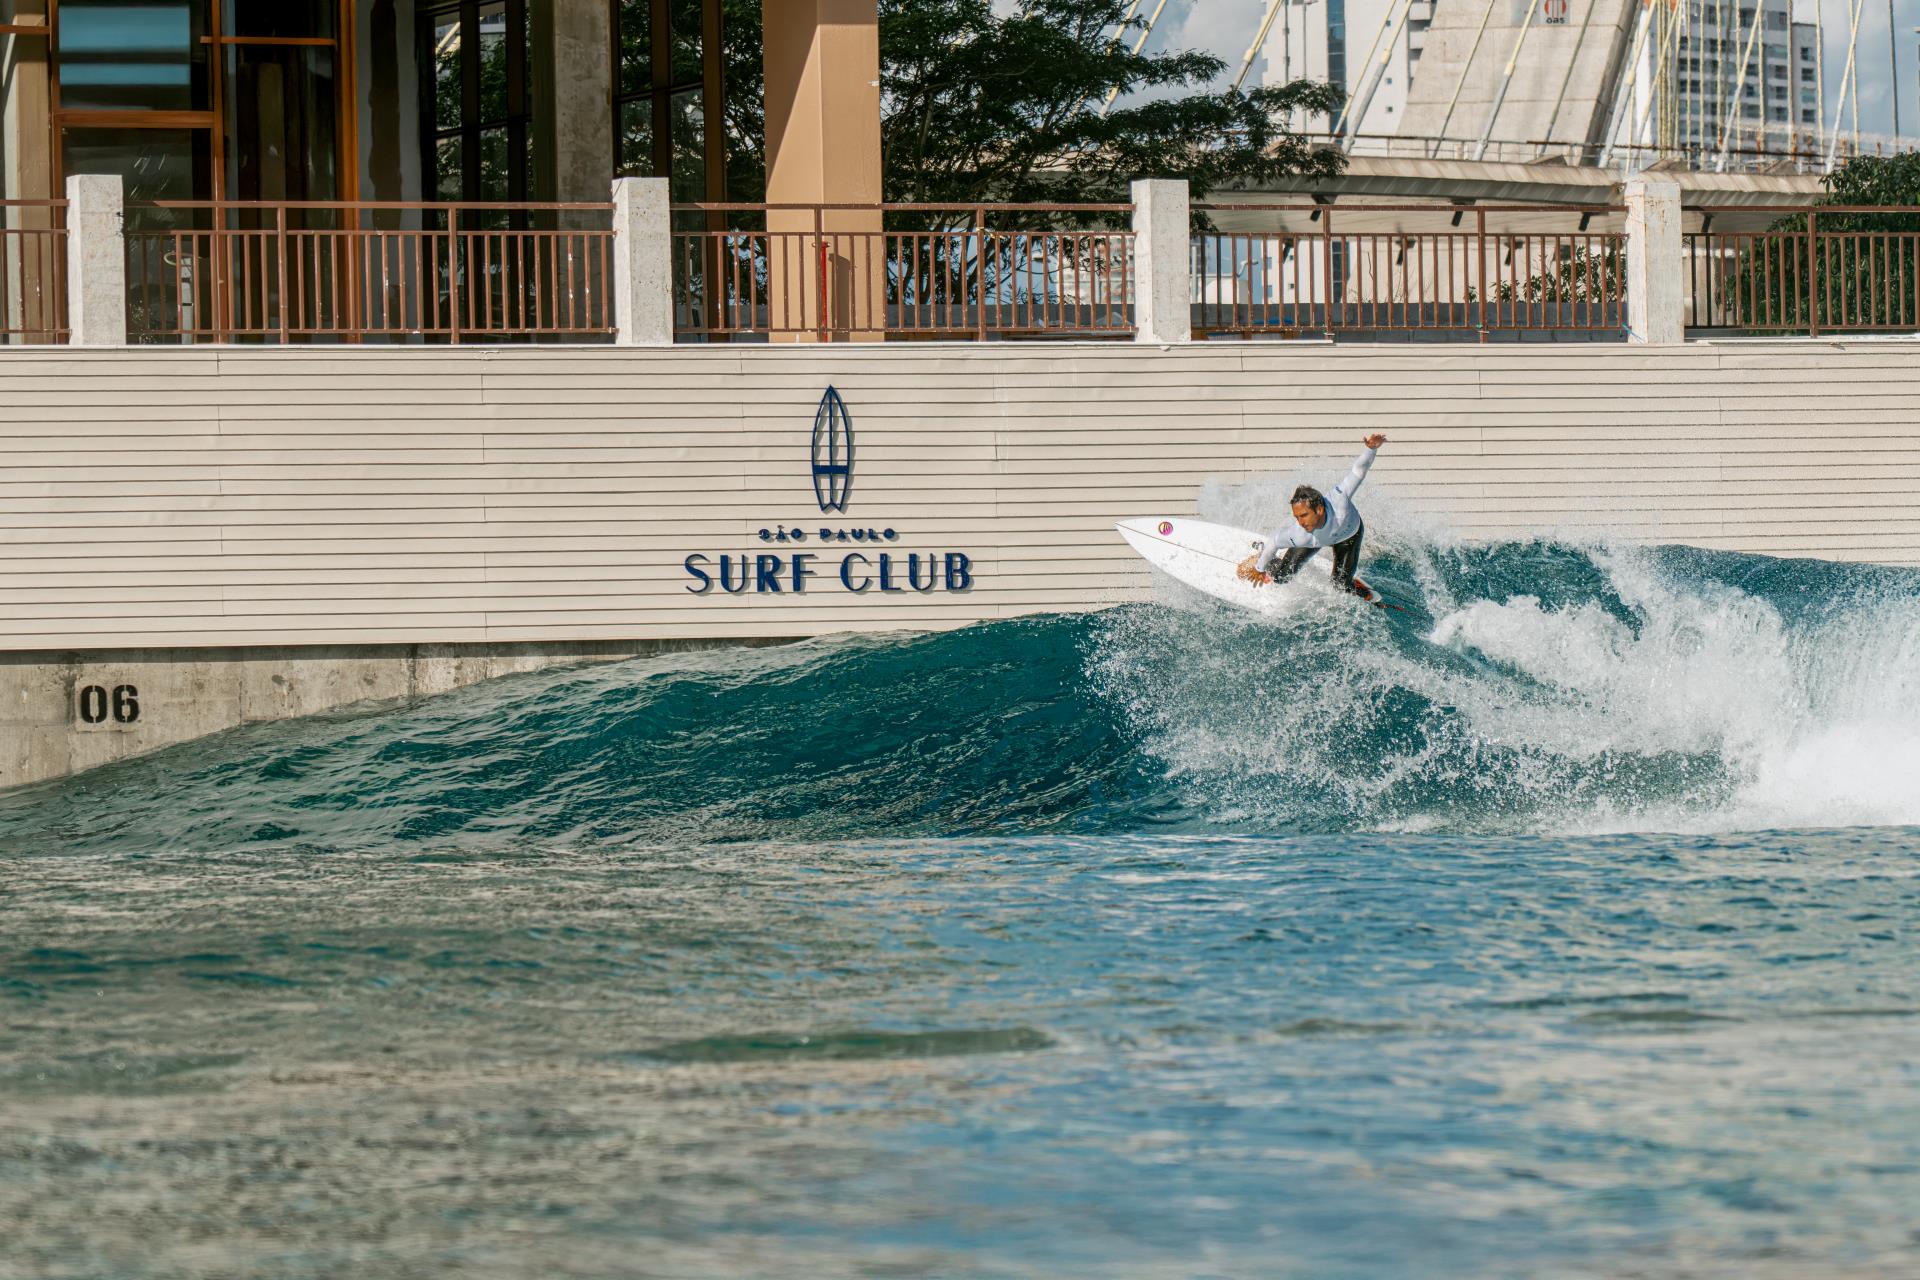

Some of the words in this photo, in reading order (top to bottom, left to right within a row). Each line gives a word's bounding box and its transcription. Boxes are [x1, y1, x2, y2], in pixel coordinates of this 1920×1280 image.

[758, 525, 803, 540] SÃO
[819, 528, 896, 540] PAULO
[684, 553, 815, 593] SURF
[839, 552, 971, 592] CLUB
[80, 684, 140, 724] 06
